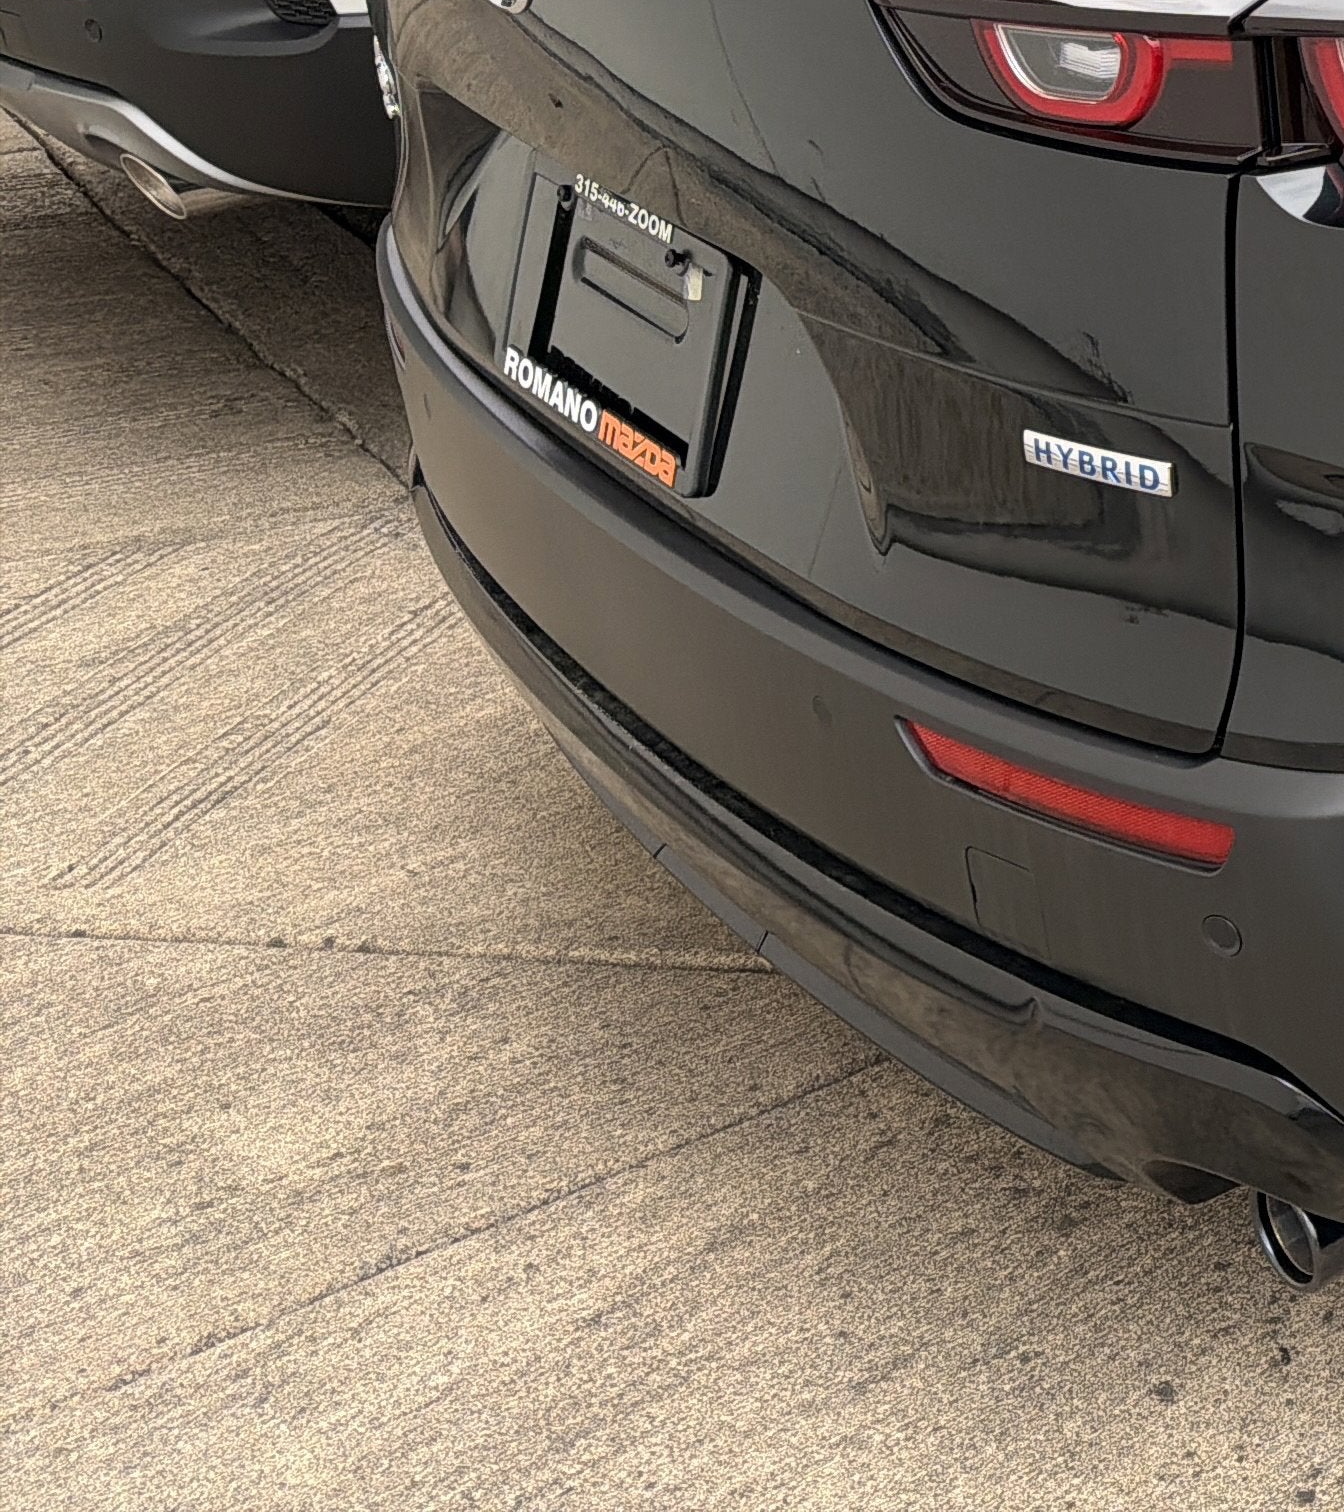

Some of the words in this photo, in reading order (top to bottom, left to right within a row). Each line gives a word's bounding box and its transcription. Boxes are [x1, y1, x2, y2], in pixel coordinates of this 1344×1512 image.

[503, 345, 599, 433] ROMANO
[598, 407, 678, 488] mazda
[1033, 437, 1160, 492] HYBRID
